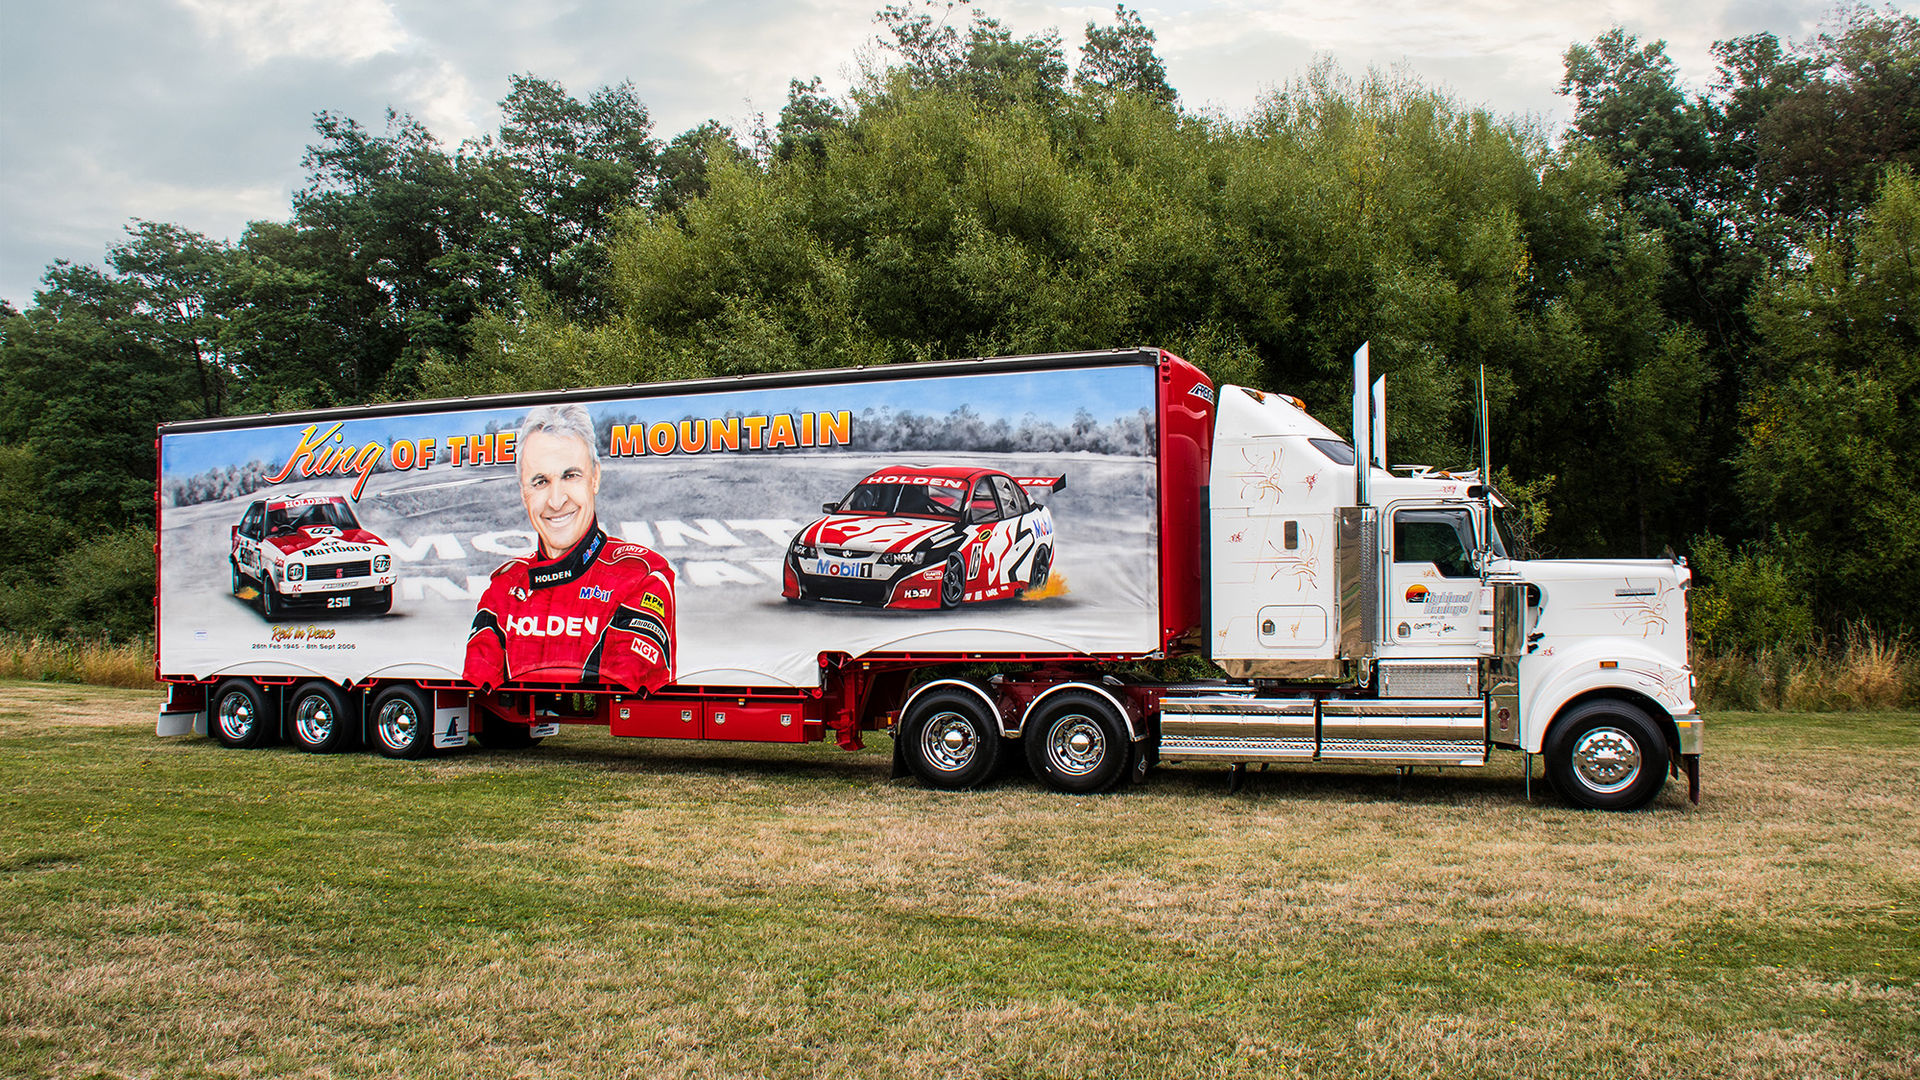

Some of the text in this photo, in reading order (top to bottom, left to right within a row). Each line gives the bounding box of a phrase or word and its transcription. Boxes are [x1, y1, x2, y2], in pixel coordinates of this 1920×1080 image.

[262, 410, 853, 502] King OF THE MOUNTAIN
[867, 475, 963, 488] HOLDEN
[284, 497, 331, 509] HOLDEN
[309, 527, 336, 535] 05
[302, 545, 372, 558] Marlboro
[893, 553, 914, 563] NGK
[816, 559, 860, 577] Mobil
[379, 577, 390, 585] AC
[535, 569, 573, 583] HOLDEN
[292, 584, 303, 592] AC
[327, 596, 352, 609] 2SM
[644, 594, 664, 609] RPM
[1423, 591, 1472, 606] Highland
[1423, 603, 1468, 616] Haulage
[506, 614, 599, 637] HOLDEN
[271, 625, 336, 642] Rest in Peace
[319, 643, 336, 651] Sept
[633, 639, 657, 662] NGK
